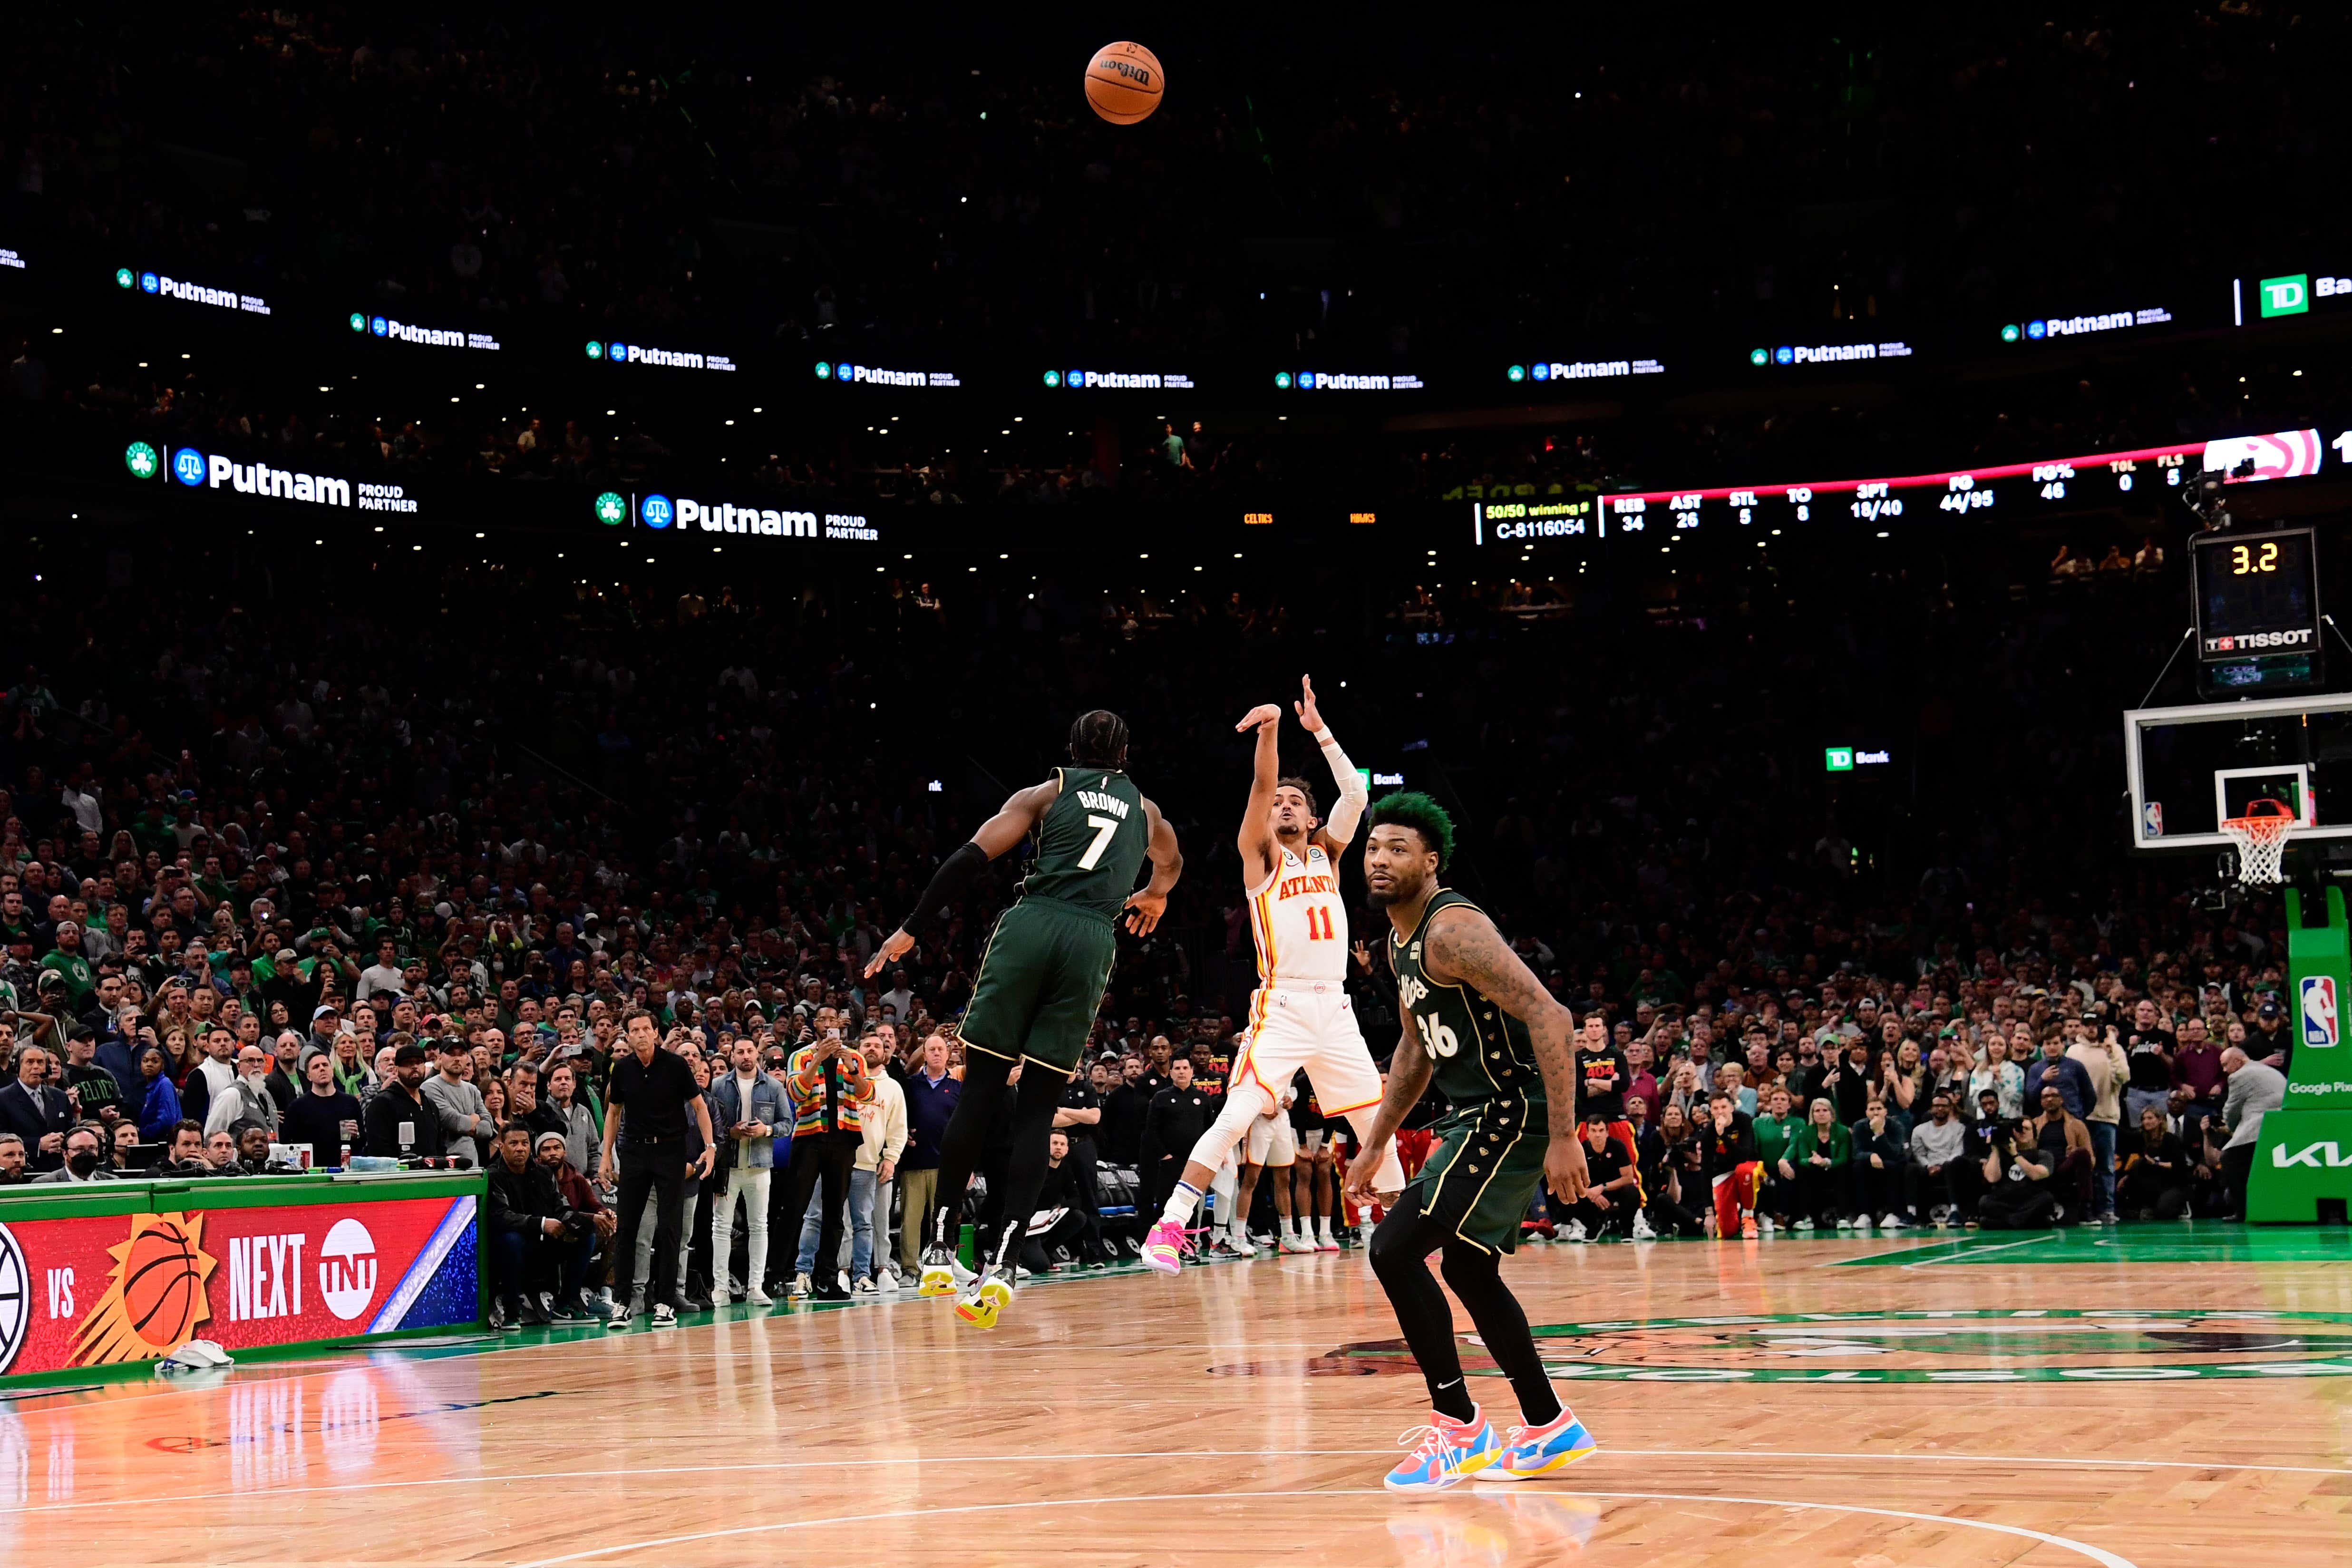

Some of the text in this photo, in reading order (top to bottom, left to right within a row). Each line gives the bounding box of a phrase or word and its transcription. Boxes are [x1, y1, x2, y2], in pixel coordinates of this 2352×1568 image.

[1100, 60, 1149, 86] Wilson
[0, 249, 18, 259] OUD
[160, 277, 237, 308] Putnam
[2266, 276, 2352, 308] TD Ba
[241, 295, 264, 306] PROUD
[241, 302, 271, 315] PARTNER
[2136, 308, 2164, 320] PROUD
[2137, 313, 2171, 324] PARTNER
[2047, 312, 2132, 337] Putnam
[389, 321, 464, 347] Putnam
[468, 333, 494, 343] PROUD
[468, 340, 500, 350] PARTNER
[1879, 342, 1905, 350] PROUD
[1879, 348, 1912, 357] PARTNER
[628, 346, 703, 368] Putnam
[706, 355, 729, 364] PROUD
[1795, 344, 1876, 363] Putnam
[707, 361, 736, 371] PARTNER
[1551, 361, 1629, 380] Putnam
[1633, 365, 1664, 374] PARTNER
[854, 366, 926, 386] Putnam
[930, 379, 960, 387] PARTNER
[1085, 372, 1160, 388] Putnam
[1316, 373, 1389, 389] Putnam
[1392, 381, 1423, 389] PARTNER
[209, 455, 350, 506] Putnam
[1614, 453, 2184, 513] REB AST STL TO 3PT FG FG% TOL FLS
[358, 483, 403, 498] PROUD
[359, 496, 418, 513] PARTNER
[1622, 468, 2179, 531] 34 26 5 8 18/40 44/95 46 0 5
[676, 499, 817, 537] Putnam
[1244, 513, 1273, 524] CELTICS
[1350, 513, 1376, 524] HAWKS
[1486, 504, 1526, 519] 50/50
[1528, 503, 1578, 516] winning
[825, 514, 866, 527] PROUD
[1497, 518, 1585, 539] C-8116054
[826, 526, 878, 541] PARTNER
[2232, 543, 2278, 575] 3.2
[2235, 629, 2312, 649] TISSOT
[1829, 750, 1889, 766] TD Bank
[928, 779, 942, 791] nk
[1373, 773, 1404, 785] Bank
[1077, 791, 1129, 820] BROWN
[1077, 814, 1119, 871] 7
[1279, 875, 1338, 901] ATLANTA
[1307, 905, 1335, 941] 11
[1416, 1012, 1458, 1060] 36
[1208, 1062, 1229, 1073] 04
[1586, 1065, 1615, 1078] 404
[2289, 1082, 2332, 1095] Google
[47, 1267, 74, 1319] VS
[229, 1233, 305, 1321] NEXT
